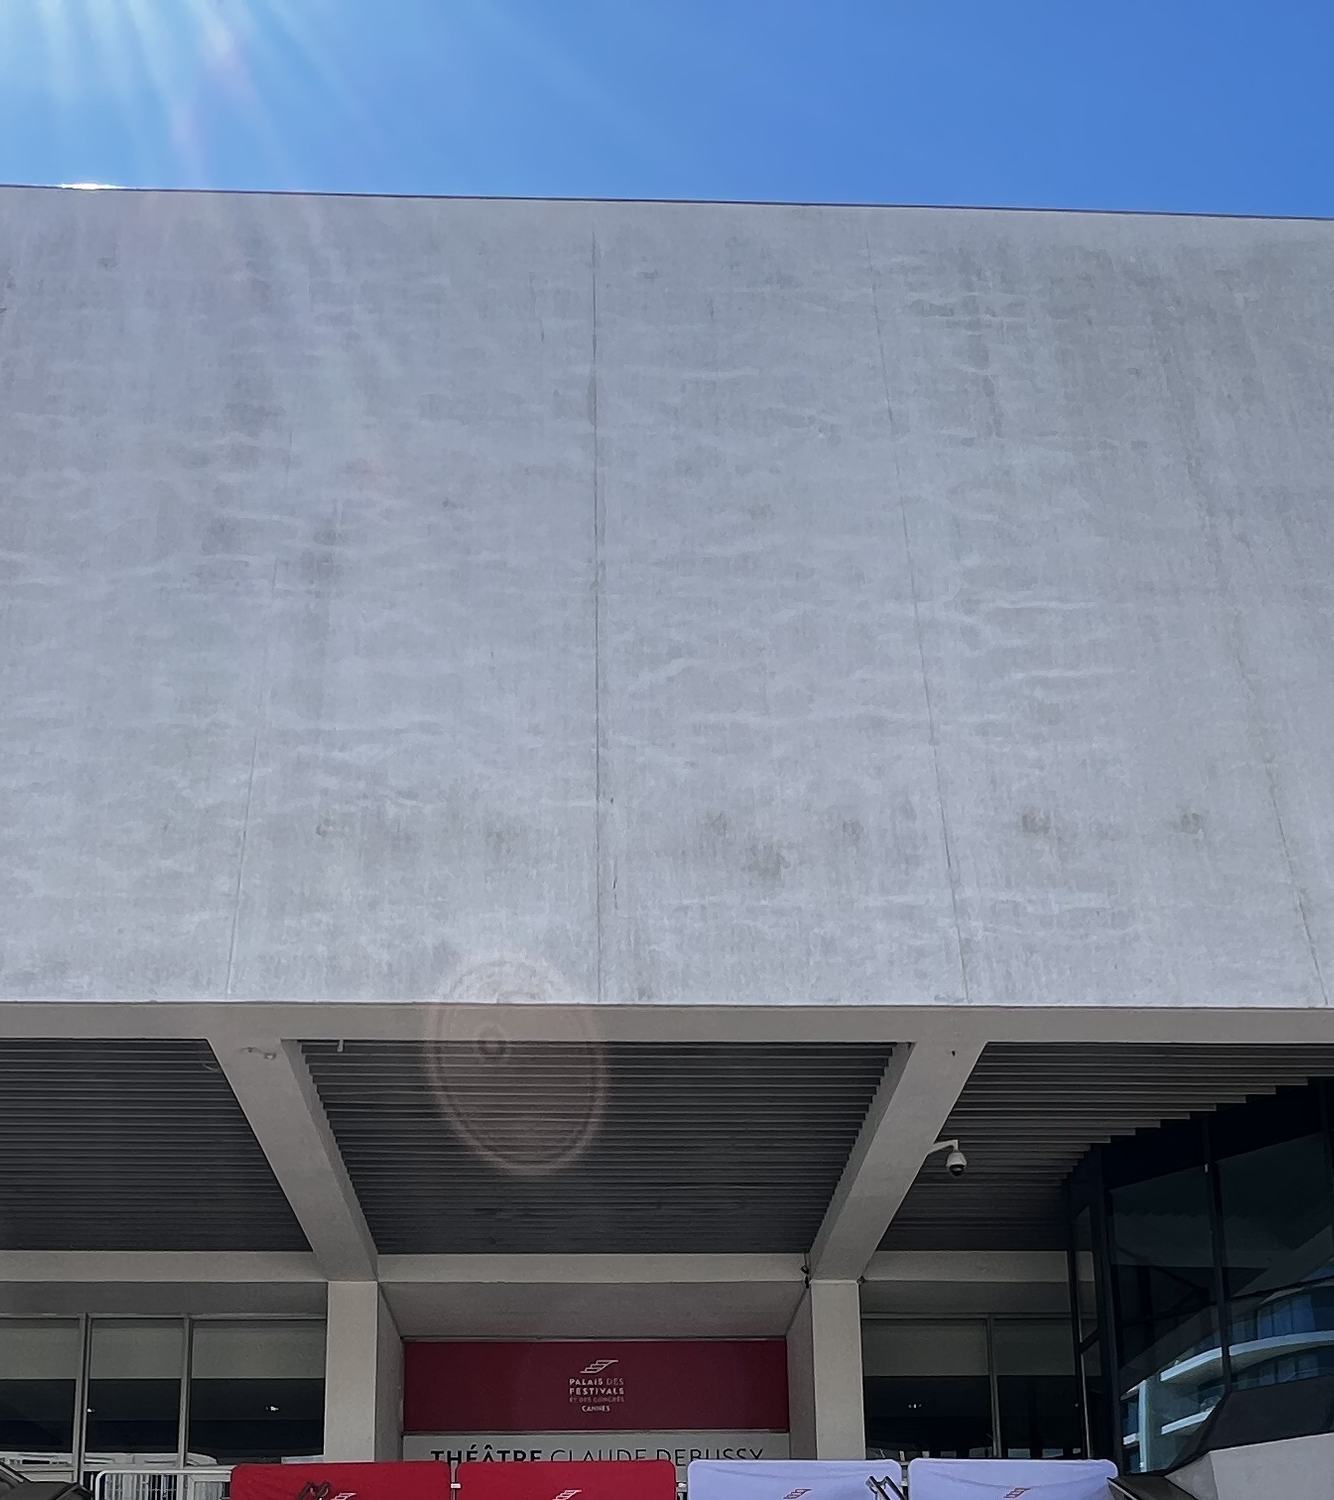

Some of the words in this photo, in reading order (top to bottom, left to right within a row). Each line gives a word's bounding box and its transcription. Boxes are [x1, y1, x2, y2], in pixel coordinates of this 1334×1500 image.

[569, 1378, 603, 1386] PALAIS
[606, 1377, 624, 1386] DES
[569, 1387, 625, 1396] FESTIVALS
